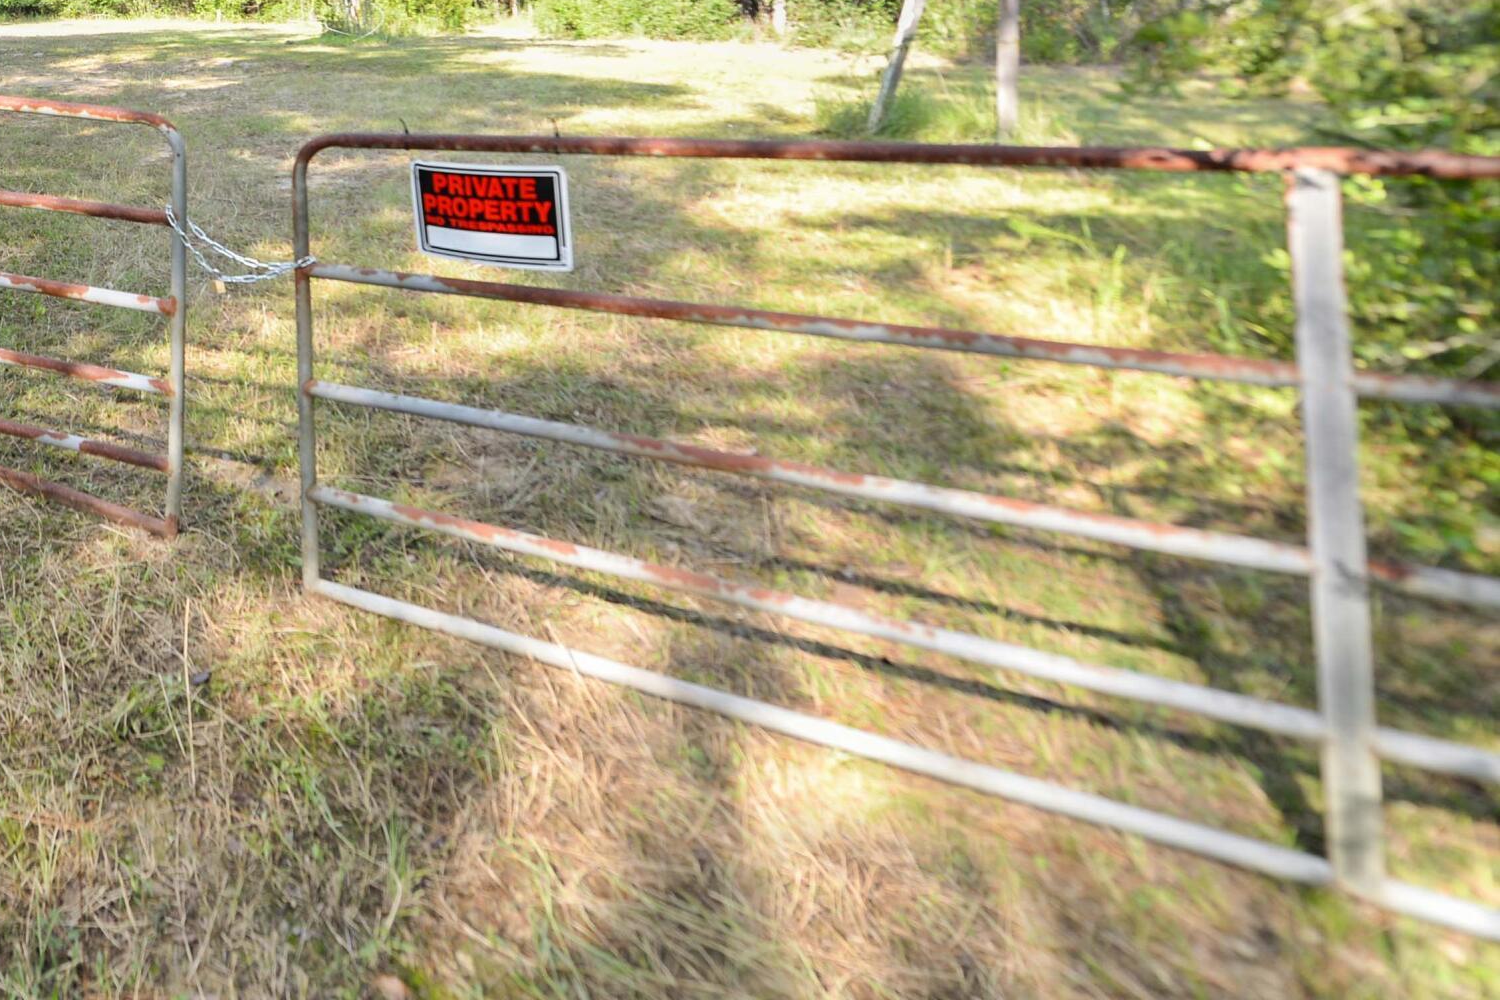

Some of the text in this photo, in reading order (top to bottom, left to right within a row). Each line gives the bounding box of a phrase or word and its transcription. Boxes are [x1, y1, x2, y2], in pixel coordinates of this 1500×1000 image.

[432, 173, 537, 199] PRIVATE
[423, 193, 551, 222] PROPERTY
[426, 216, 554, 234] NO TRESPASSING
